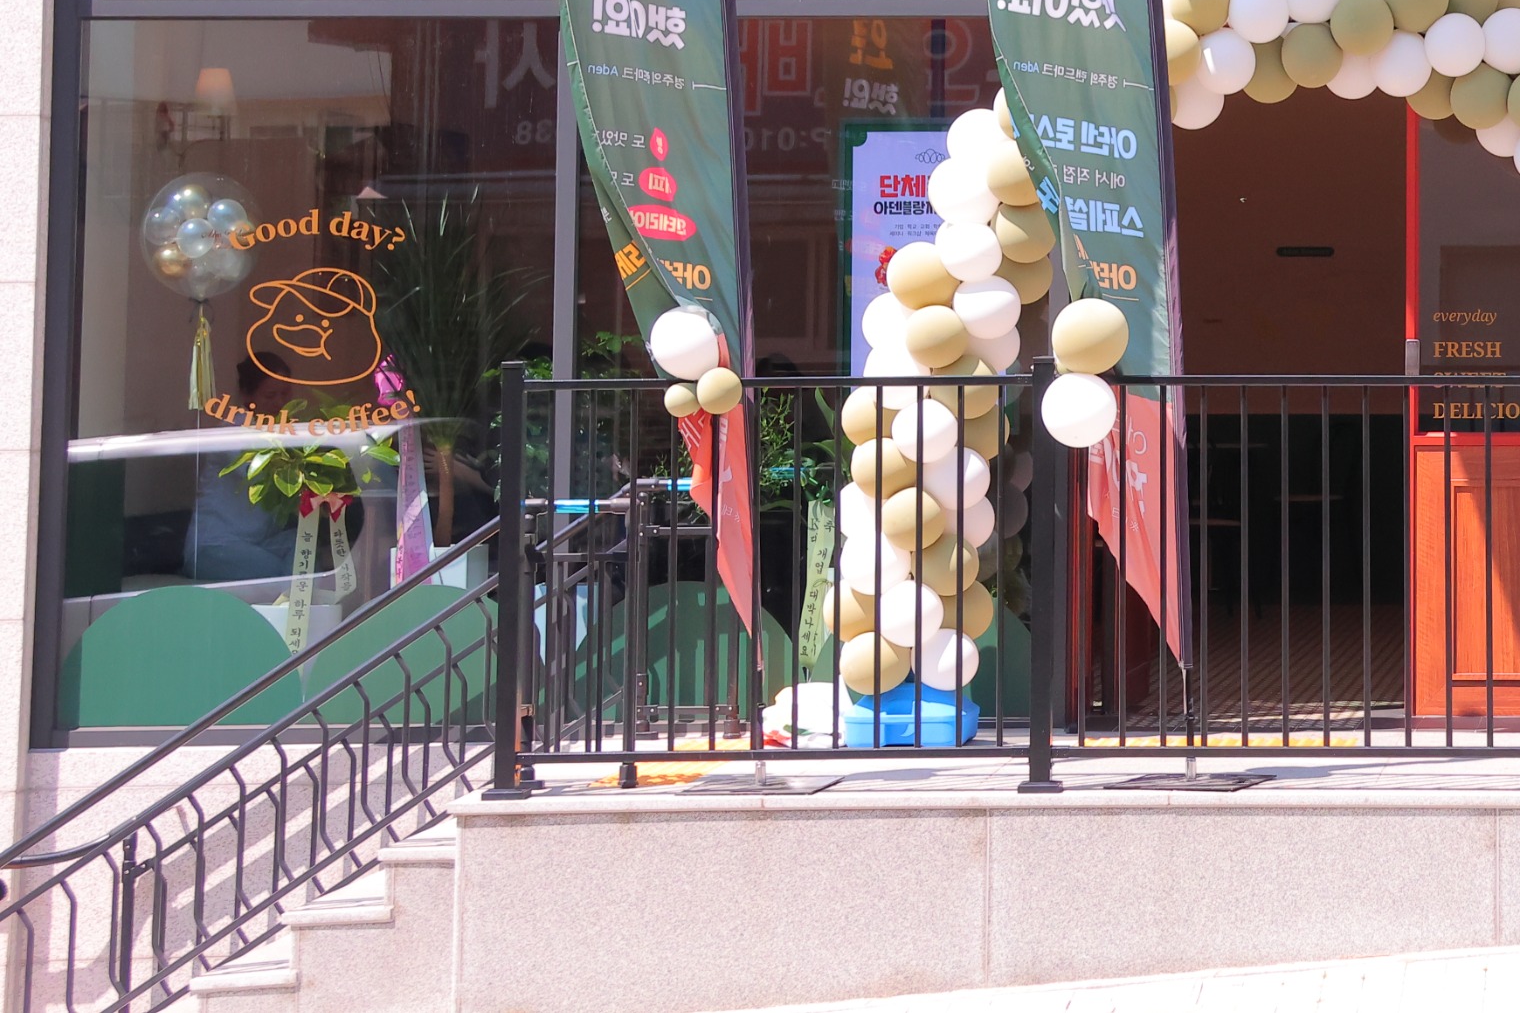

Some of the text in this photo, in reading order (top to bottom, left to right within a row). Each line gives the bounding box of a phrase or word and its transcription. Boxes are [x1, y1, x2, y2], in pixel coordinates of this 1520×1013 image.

[879, 174, 928, 198] 단체
[229, 208, 320, 251] Good
[329, 211, 406, 251] day?
[1433, 309, 1497, 325] everyday
[1433, 341, 1502, 358] FRESH
[204, 389, 421, 437] drink coffee!
